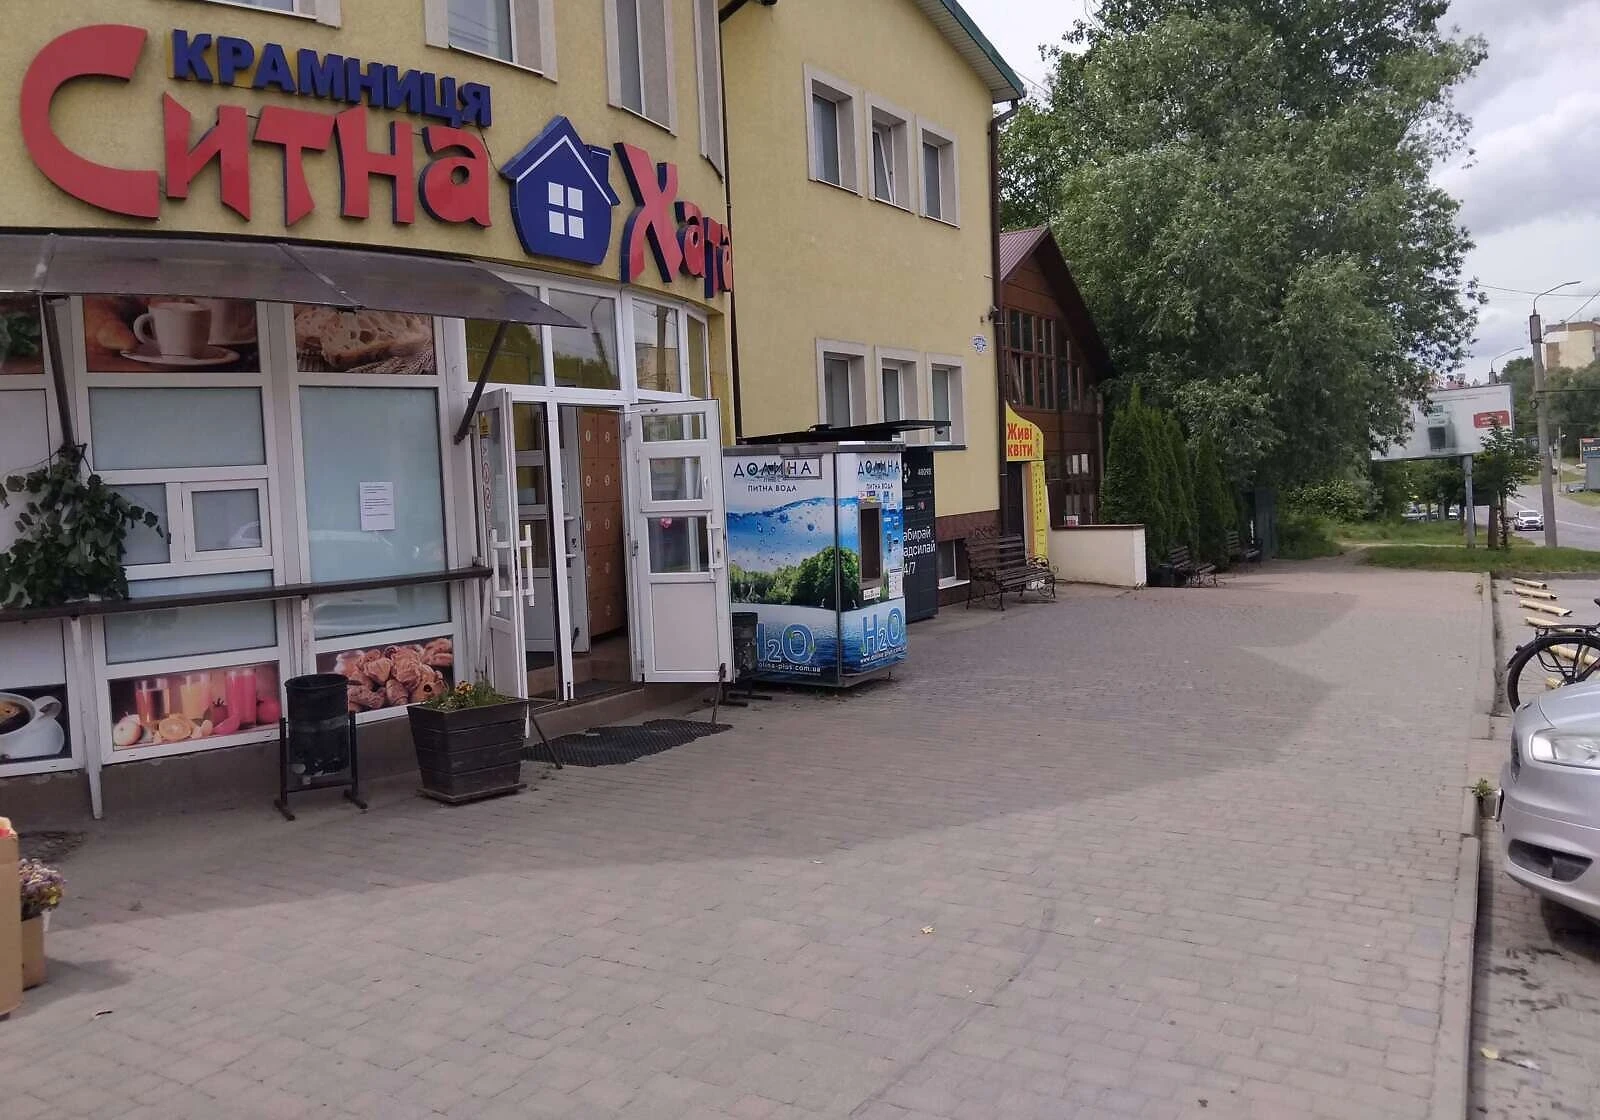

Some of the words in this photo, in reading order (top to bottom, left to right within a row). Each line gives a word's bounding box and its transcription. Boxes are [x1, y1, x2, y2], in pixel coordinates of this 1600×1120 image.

[171, 28, 492, 127] КРАМНИЦЯ
[20, 23, 493, 227] Ситна
[613, 142, 733, 298] Хата
[1007, 423, 1032, 440] Живі
[733, 461, 812, 478] ДОЛИНА
[747, 484, 773, 493] ПИТНА
[775, 484, 797, 493] ВОДА
[903, 526, 931, 542] абирай
[903, 540, 936, 558] адсилай
[903, 562, 916, 577] 4/7
